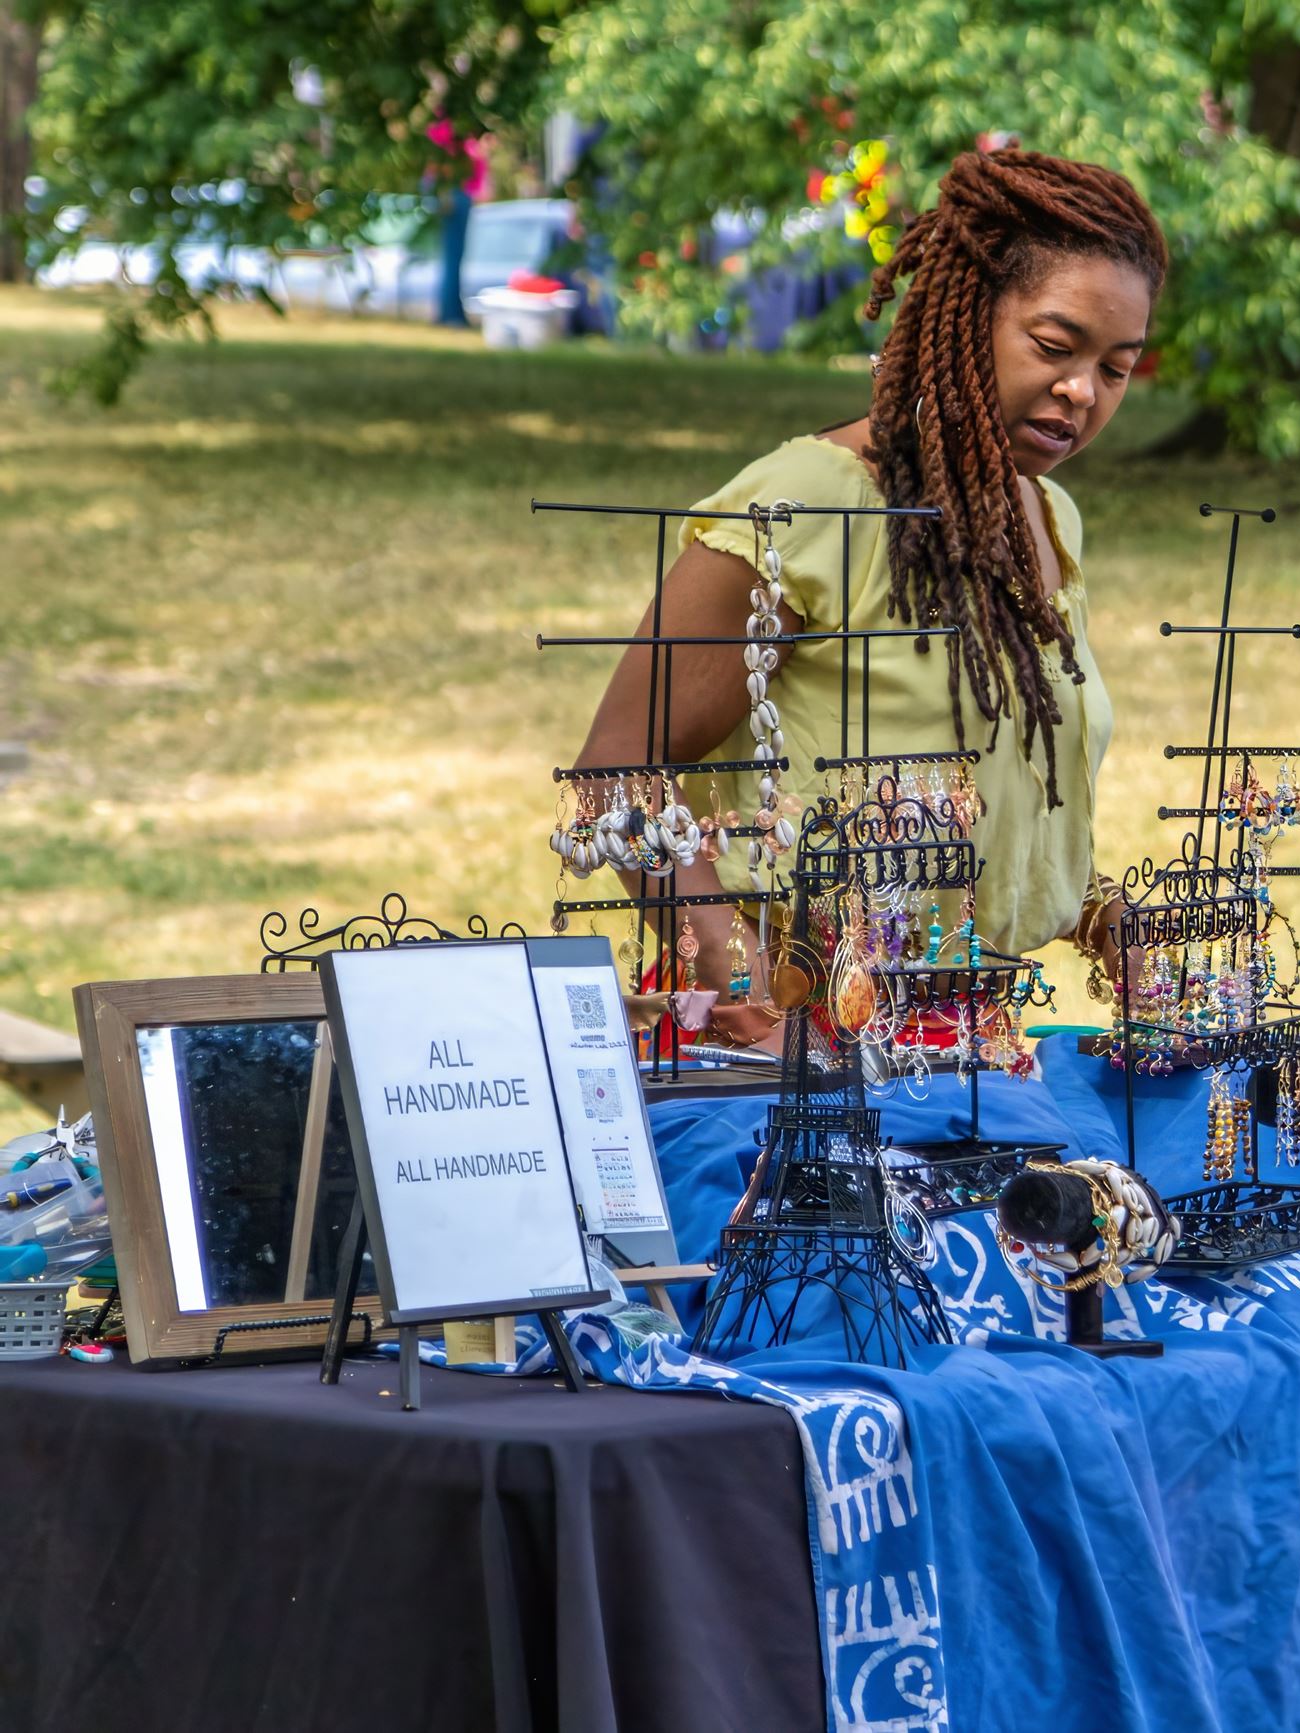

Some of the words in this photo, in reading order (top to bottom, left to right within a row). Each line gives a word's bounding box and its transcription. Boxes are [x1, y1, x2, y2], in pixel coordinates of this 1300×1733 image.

[428, 1039, 474, 1069] ALL
[383, 1078, 530, 1115] HANDMADE
[396, 1159, 432, 1183] ALL
[434, 1150, 547, 1180] HANDMADE
